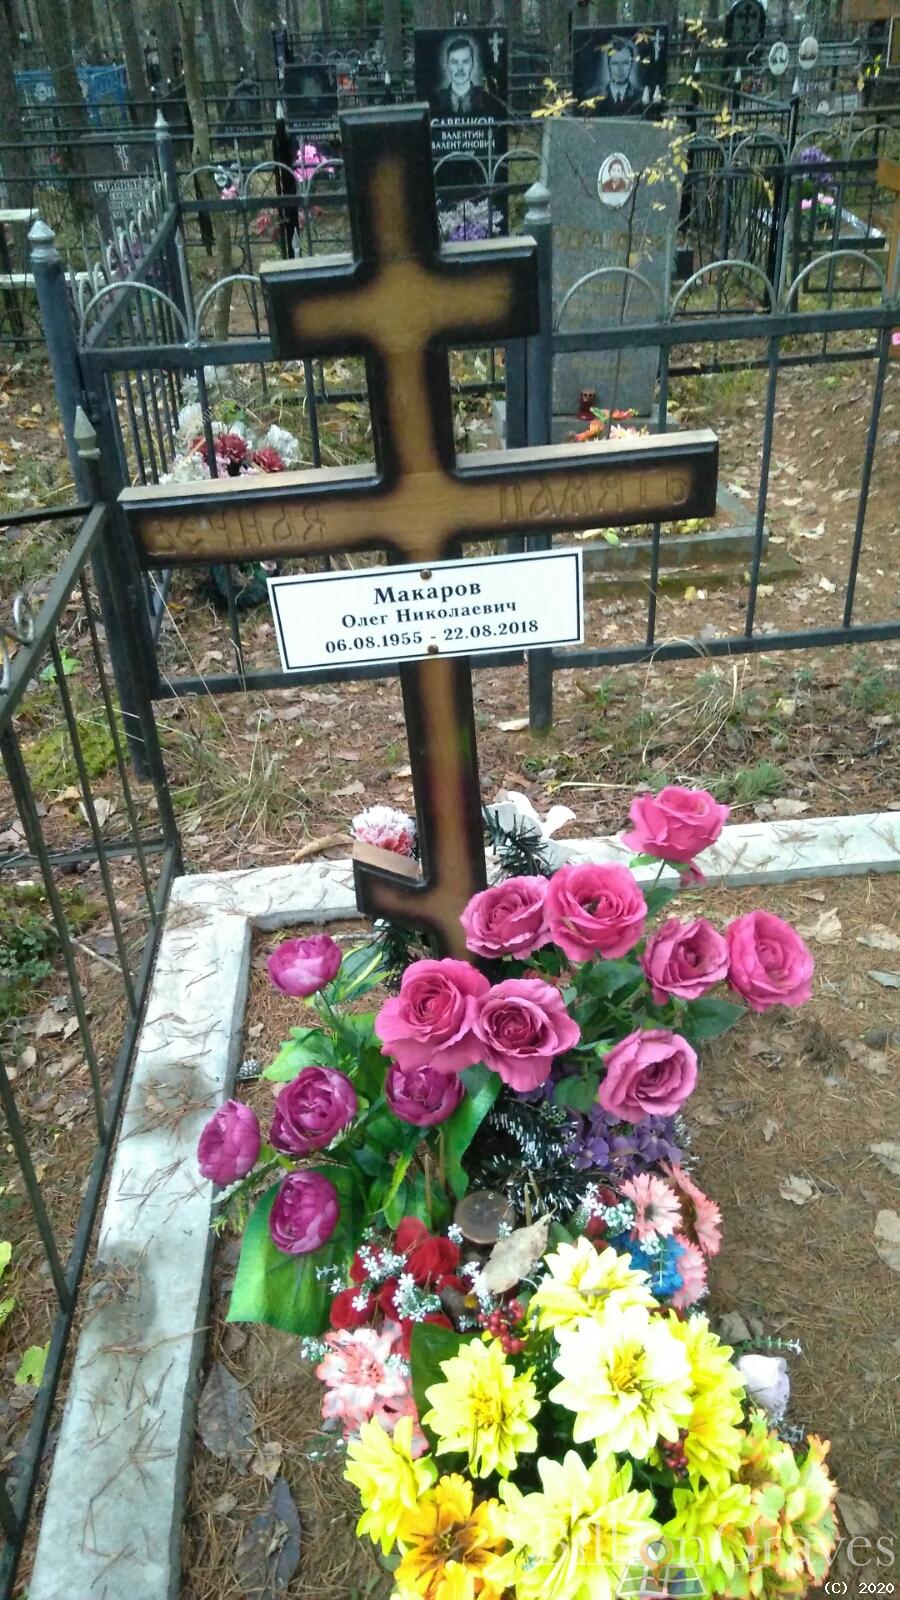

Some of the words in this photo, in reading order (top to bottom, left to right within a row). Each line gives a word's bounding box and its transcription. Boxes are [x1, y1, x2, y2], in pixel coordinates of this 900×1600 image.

[441, 130, 485, 140] ВАЛЕНТИН
[374, 582, 482, 605] Макаров
[341, 612, 388, 629] Олег
[396, 601, 517, 623] Николаевич
[325, 631, 423, 654] 06.08.1955
[443, 619, 539, 641] 22.08.2018
